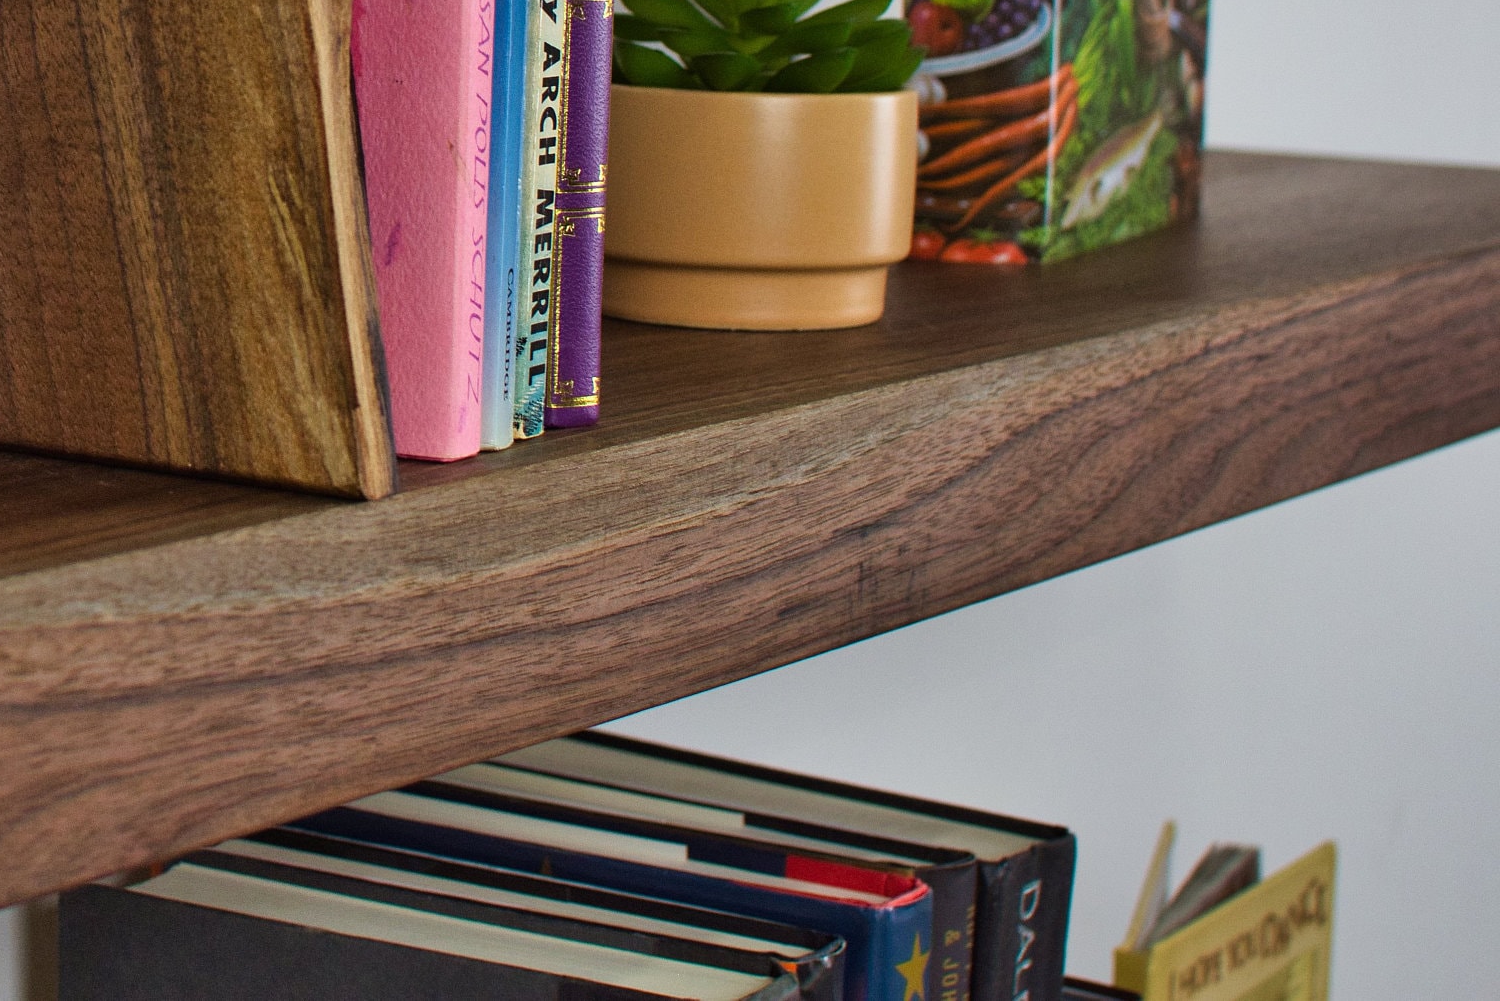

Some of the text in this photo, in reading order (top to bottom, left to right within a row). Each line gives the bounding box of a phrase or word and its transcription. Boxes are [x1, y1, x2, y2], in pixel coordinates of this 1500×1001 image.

[474, 92, 488, 216] POLIS
[538, 41, 562, 166] ARCH
[467, 226, 484, 405] SCHUTZ
[528, 189, 556, 387] MERRILL
